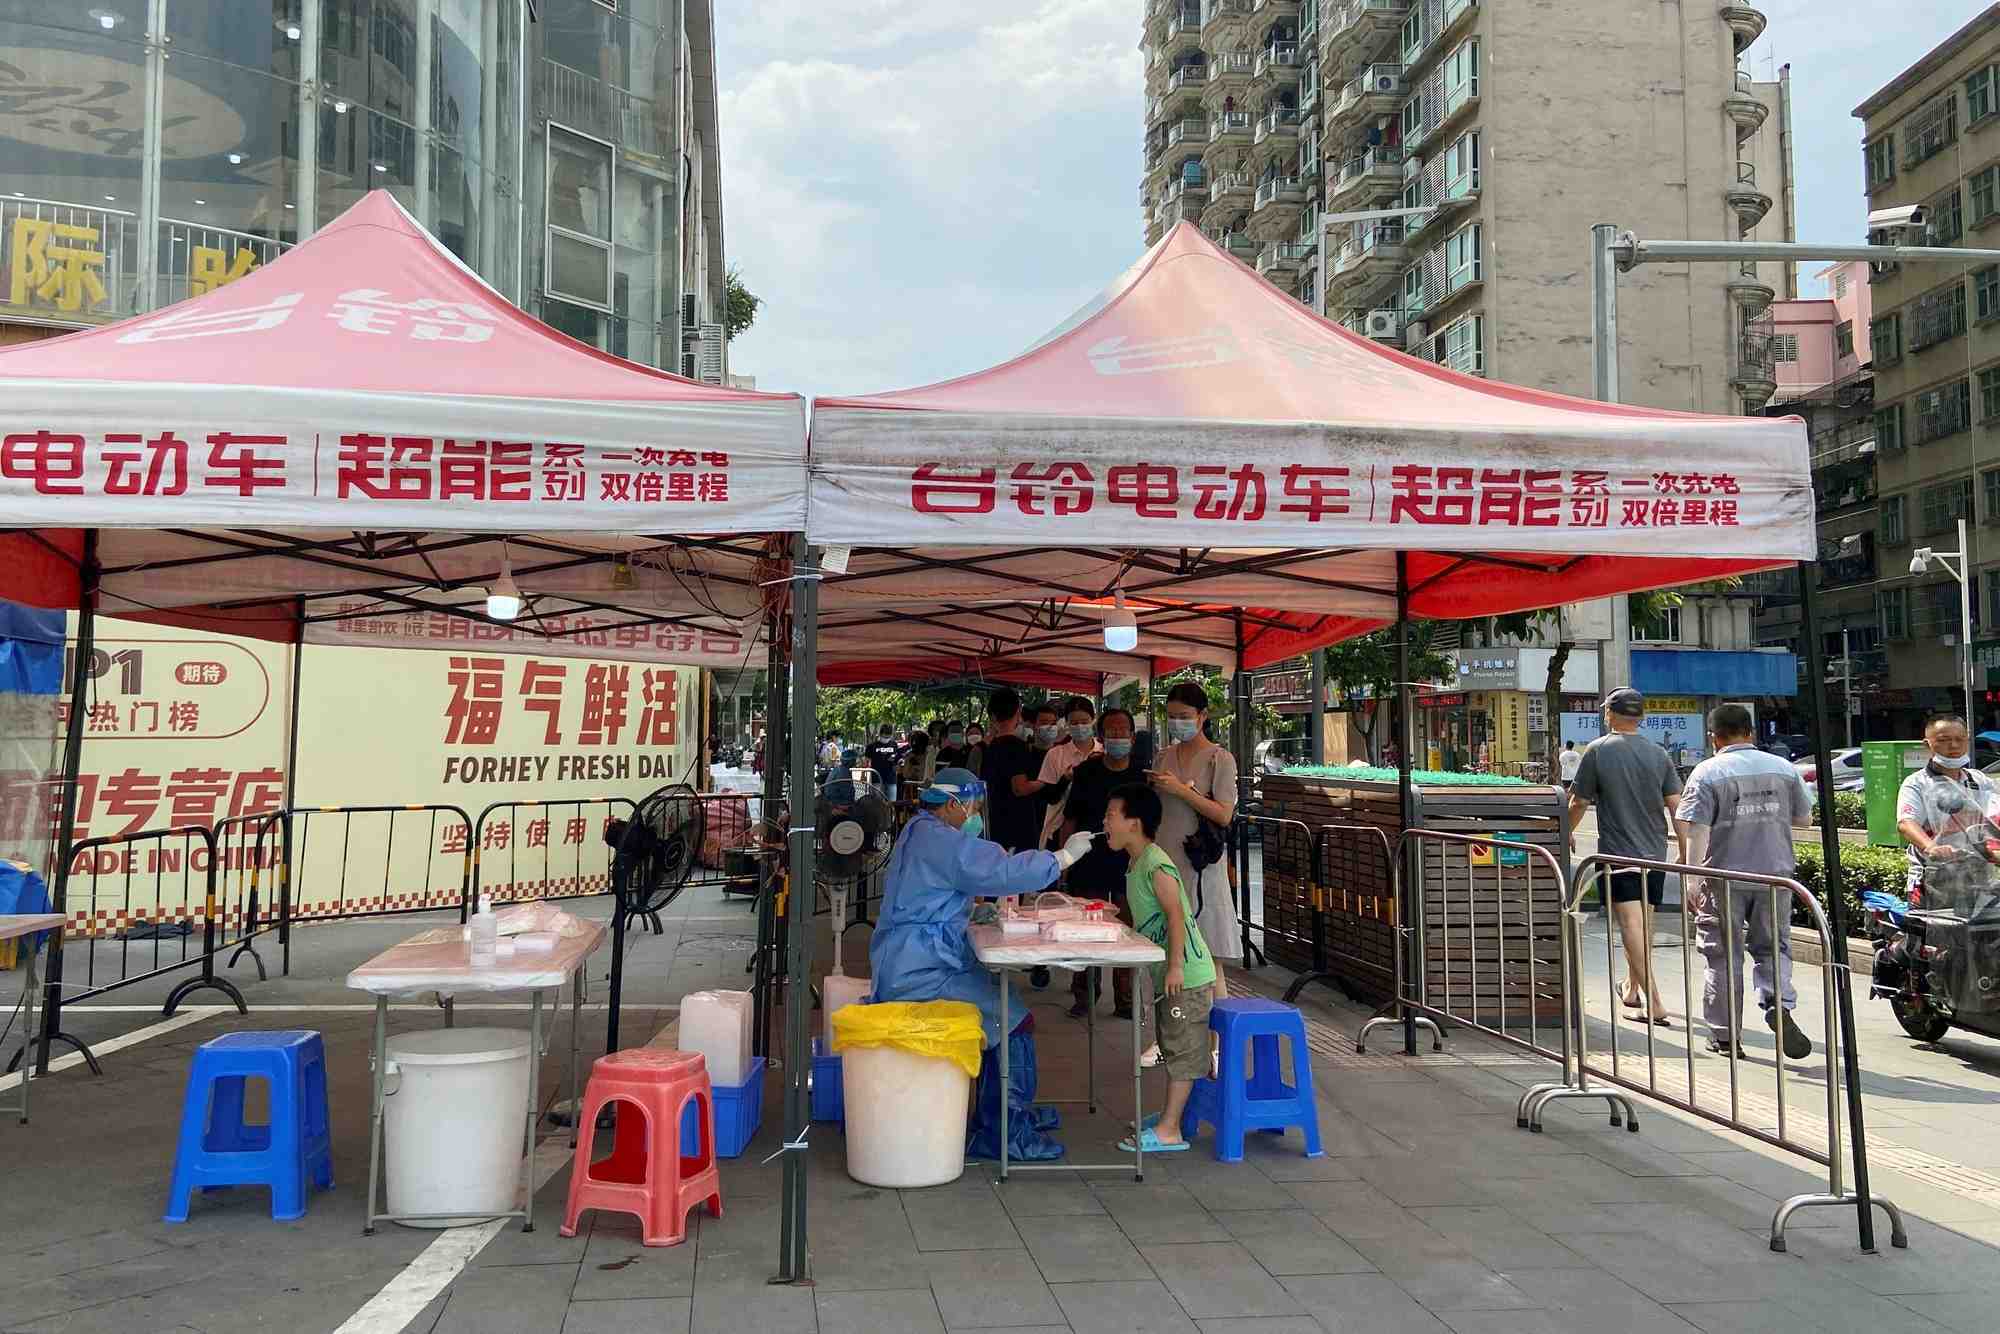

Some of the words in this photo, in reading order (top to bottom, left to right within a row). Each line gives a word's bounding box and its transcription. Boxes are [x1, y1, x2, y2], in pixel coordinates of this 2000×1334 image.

[1, 431, 288, 497] 电动车
[338, 433, 533, 501] 超能
[541, 442, 585, 502] 系列
[600, 446, 730, 468] 一次充电
[600, 472, 730, 502] 双倍里程
[911, 462, 1350, 522] 台铃电动车
[1390, 464, 1561, 526] 超能
[1568, 470, 1610, 527] 系列
[1621, 471, 1741, 496] 一次充电
[1621, 499, 1740, 527] 双倍里程
[182, 664, 222, 684] 期待
[443, 656, 679, 746] 福气鲜活
[443, 755, 550, 784] FORHEY
[557, 754, 630, 781] FRESH
[440, 815, 617, 854] 坚持使用
[149, 848, 181, 873] IN
[190, 846, 283, 872] CHINA
